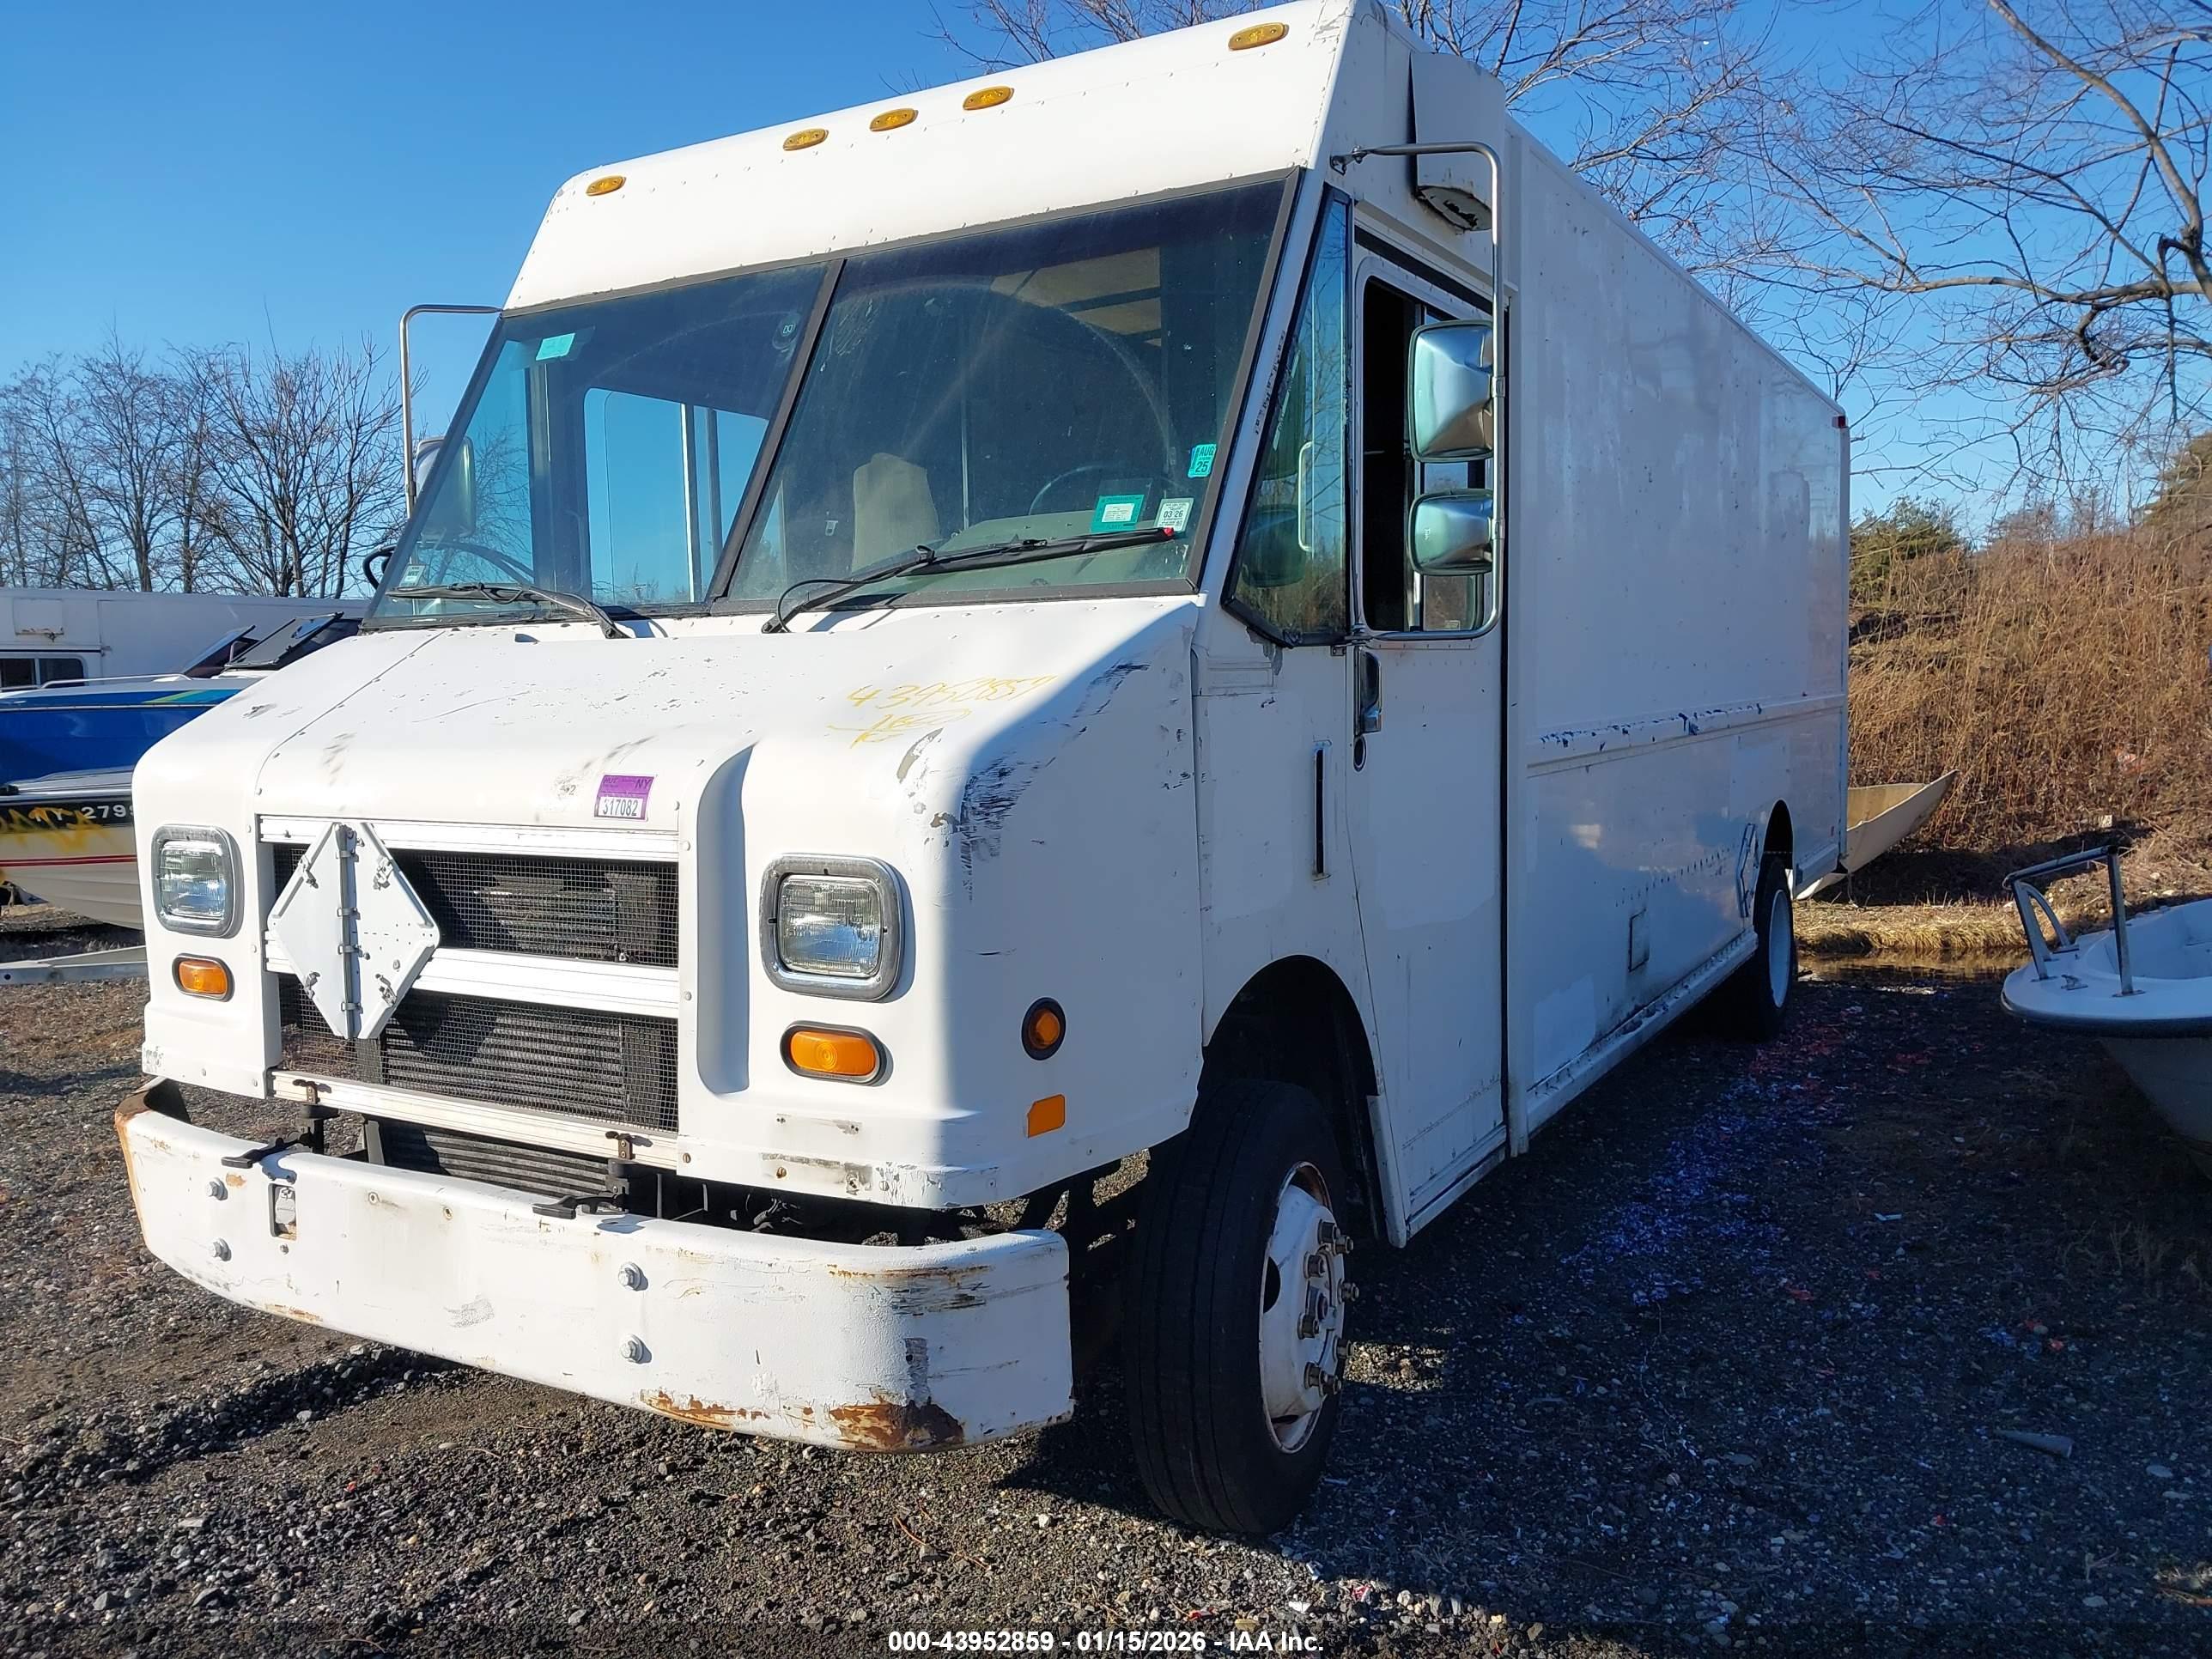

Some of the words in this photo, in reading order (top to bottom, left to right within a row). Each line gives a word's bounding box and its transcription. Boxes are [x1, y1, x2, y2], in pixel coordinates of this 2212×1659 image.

[1194, 460, 1209, 473] 25
[635, 778, 653, 789] NY
[81, 804, 134, 820] 279
[602, 798, 639, 817] 317082
